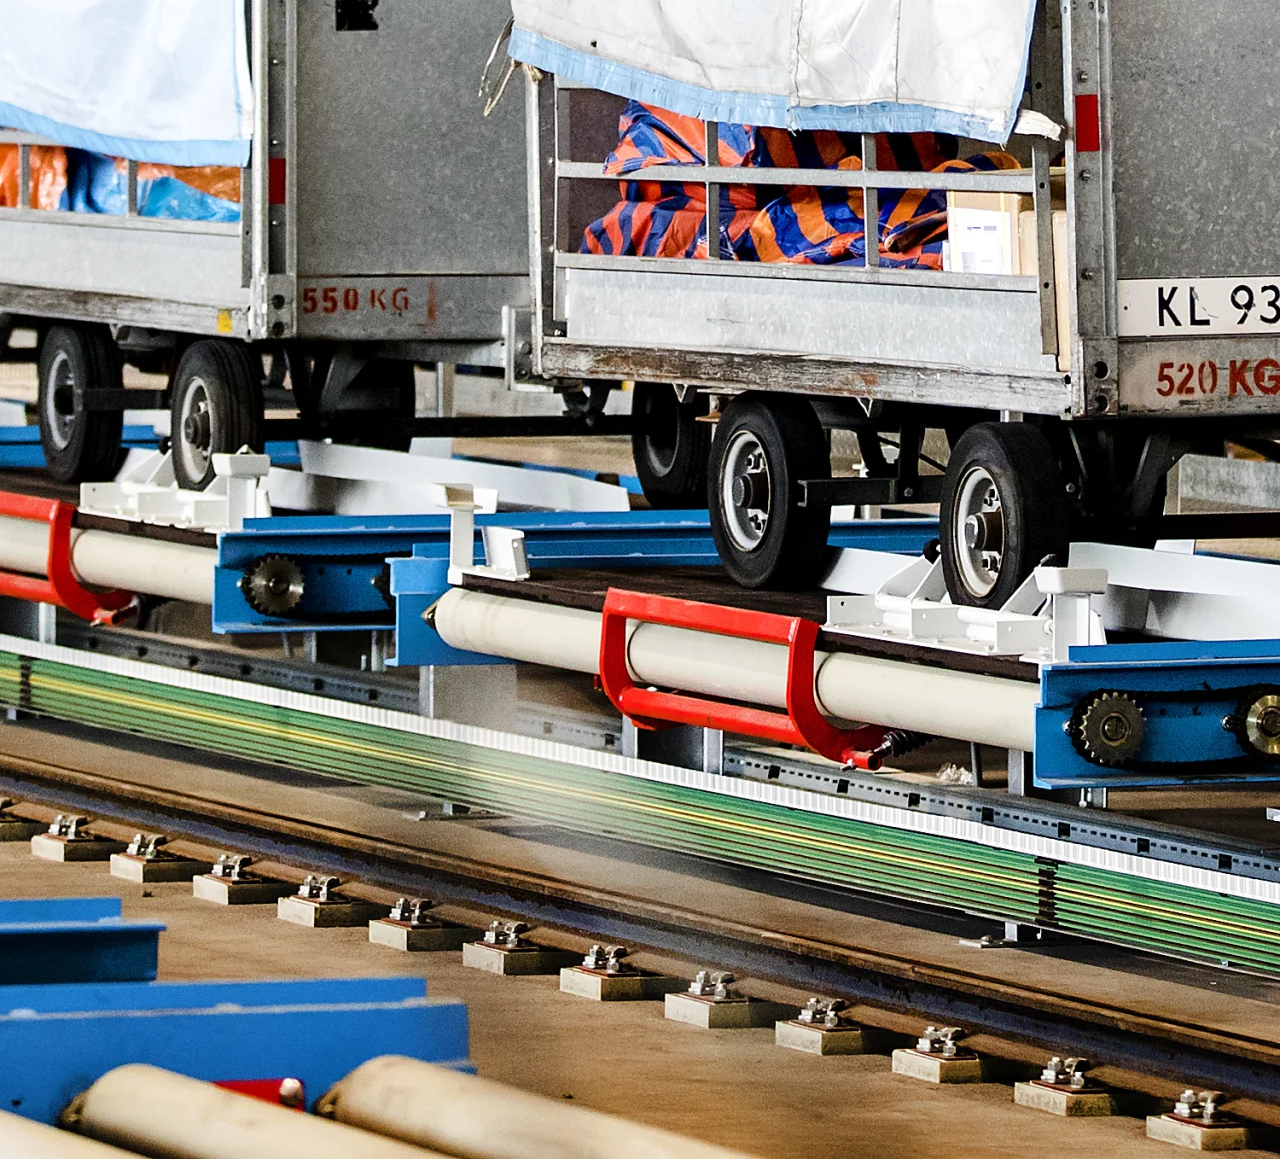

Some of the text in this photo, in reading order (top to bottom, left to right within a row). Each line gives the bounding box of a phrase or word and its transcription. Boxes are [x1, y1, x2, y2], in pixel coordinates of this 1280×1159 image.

[302, 287, 410, 314] 550 KG
[1158, 286, 1210, 326] KL
[1156, 361, 1218, 397] 520
